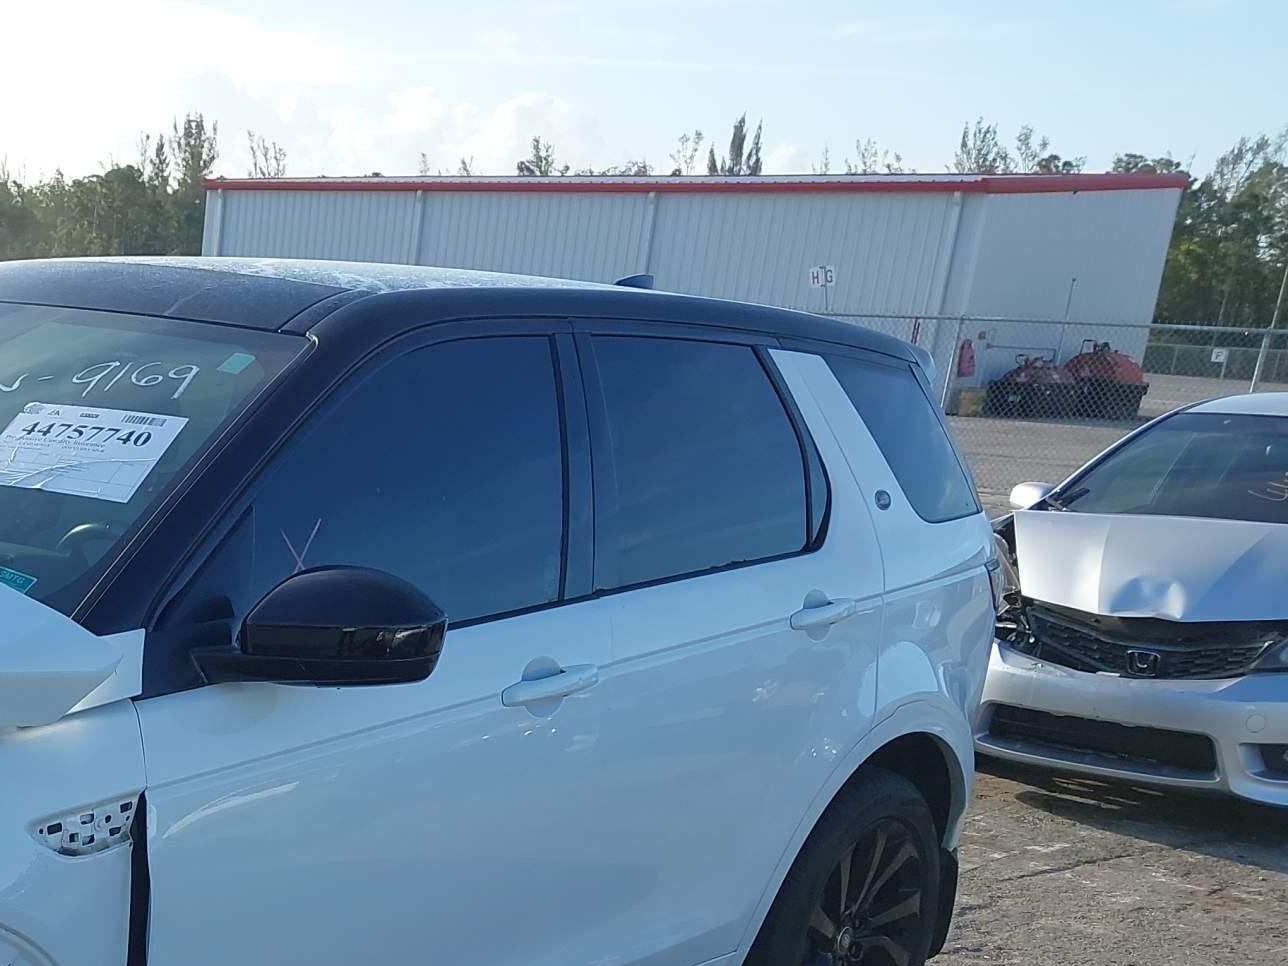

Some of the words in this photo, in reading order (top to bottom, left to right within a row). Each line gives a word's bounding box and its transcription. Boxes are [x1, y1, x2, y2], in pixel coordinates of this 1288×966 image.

[812, 270, 820, 285] H
[825, 269, 833, 283] G
[21, 420, 152, 447] 44757740
